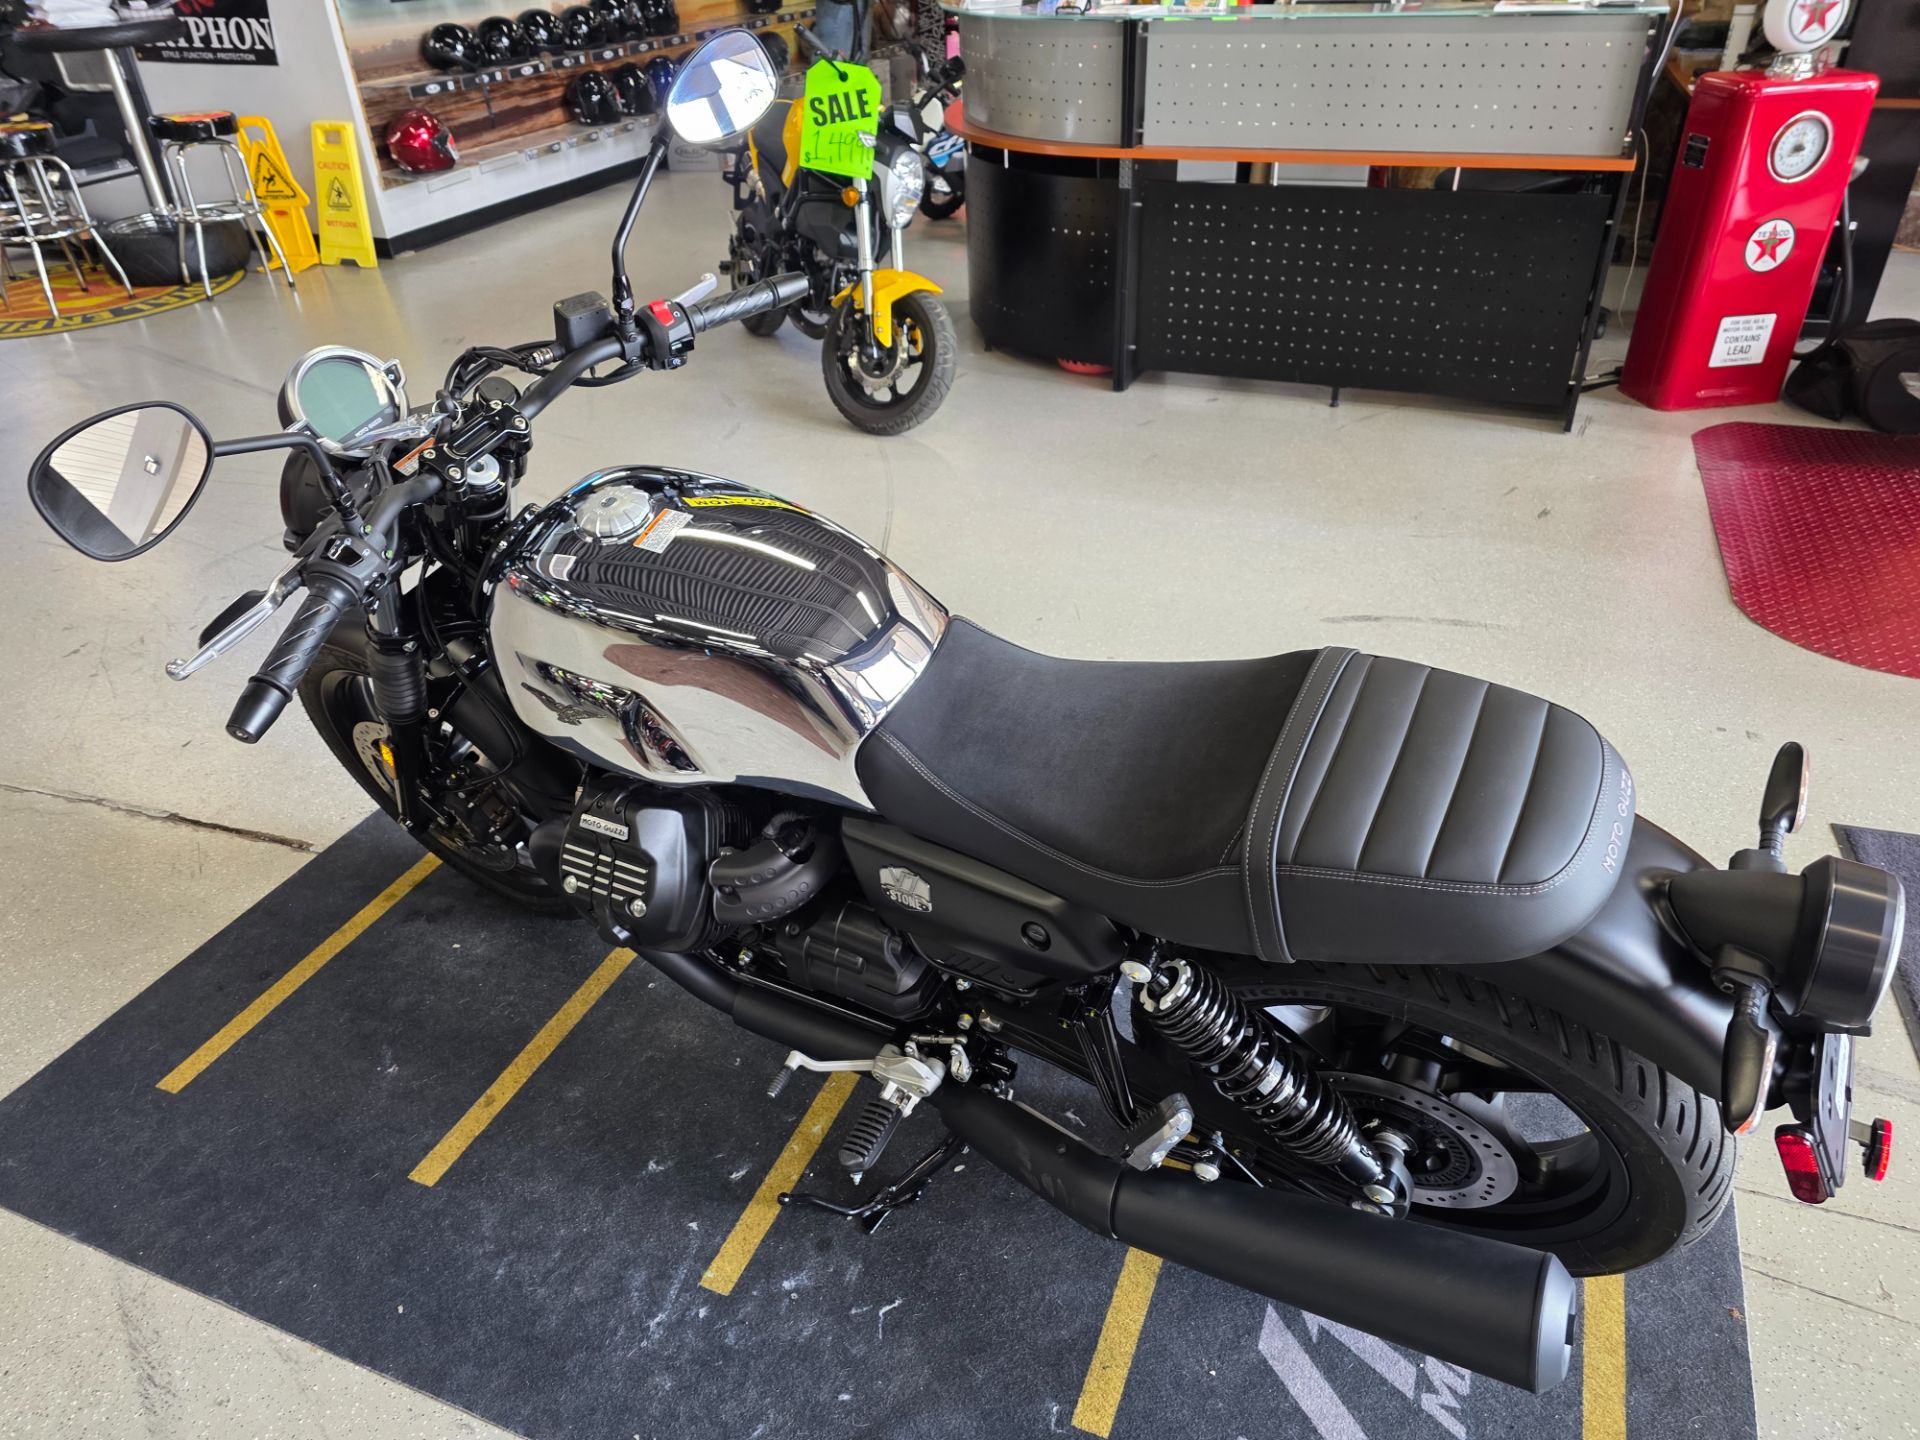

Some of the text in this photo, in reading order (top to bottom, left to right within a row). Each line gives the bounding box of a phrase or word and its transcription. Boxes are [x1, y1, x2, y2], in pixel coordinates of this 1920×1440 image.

[809, 88, 872, 127] SALE
[317, 161, 351, 170] CAUTION
[1723, 334, 1761, 344] CONTAINS
[1726, 344, 1752, 356] LEAD
[581, 817, 626, 837] MOTO GUZZI
[1602, 821, 1624, 875] MOTO
[888, 889, 923, 911] STONE
